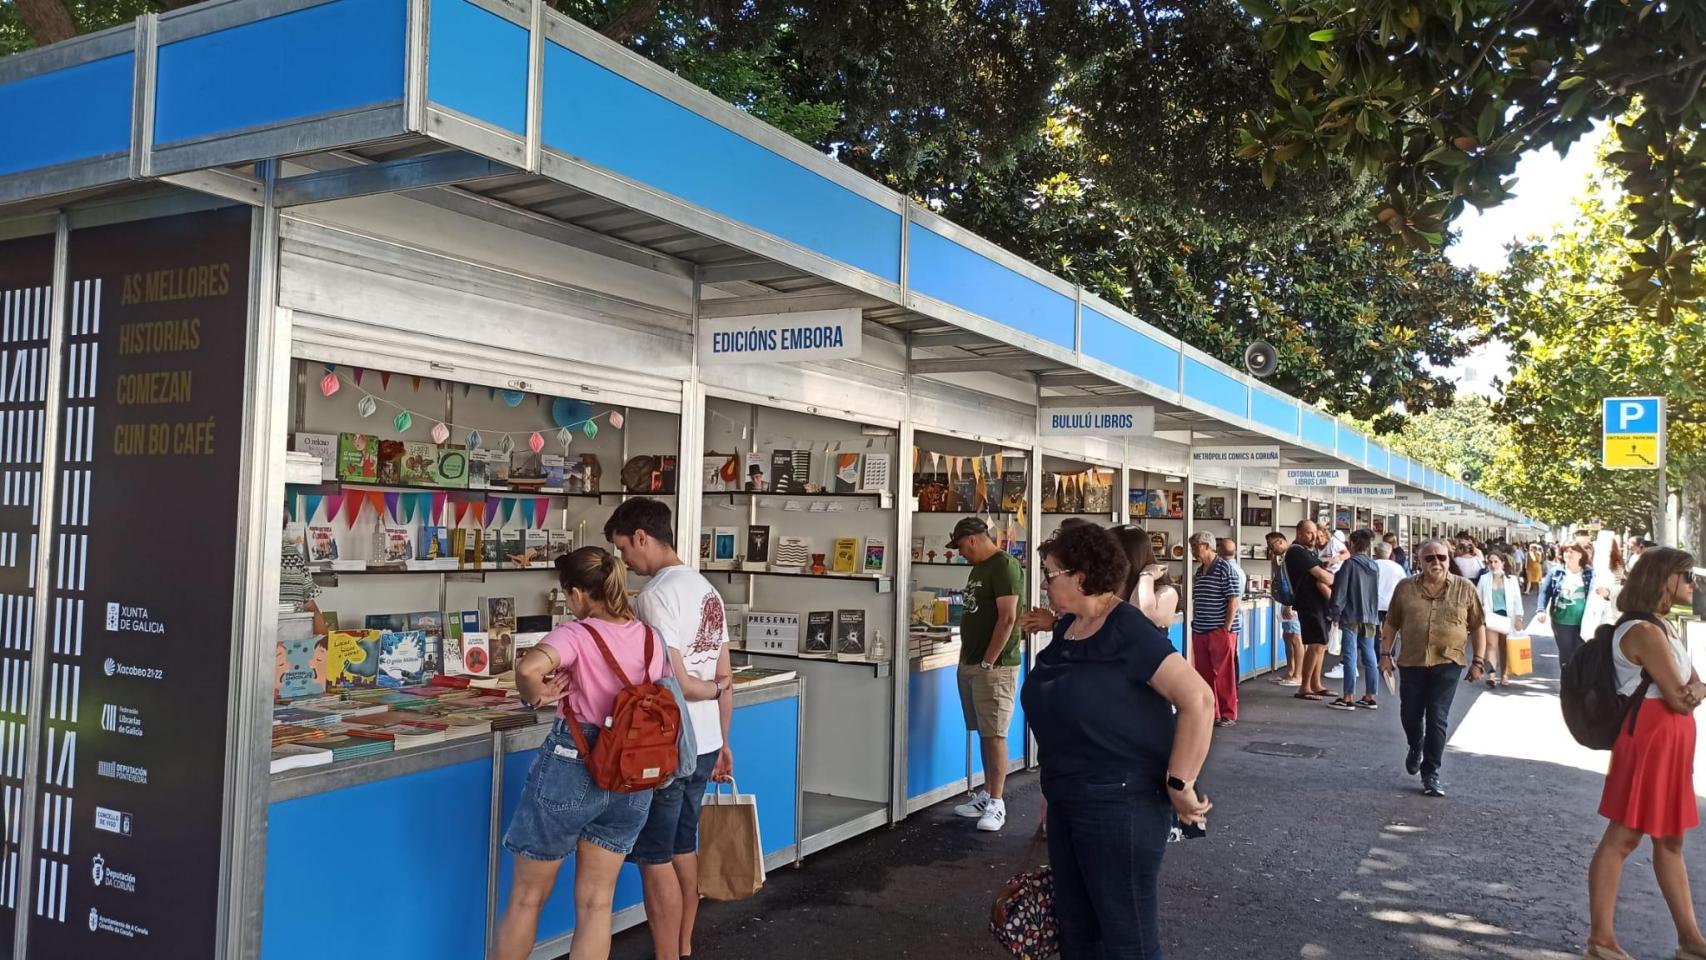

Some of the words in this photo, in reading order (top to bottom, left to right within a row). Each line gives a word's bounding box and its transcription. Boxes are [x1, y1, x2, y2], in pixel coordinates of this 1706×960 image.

[122, 274, 141, 305] AS
[146, 263, 230, 301] MELLORES
[120, 318, 200, 354] HISTORIAS
[713, 326, 777, 353] EDICIÓNS
[781, 325, 843, 350] EMBORA
[117, 371, 192, 404] COMEZAN
[1052, 411, 1092, 429] BULULÚ
[1095, 414, 1133, 428] LIBROS
[1619, 402, 1645, 430] P
[114, 424, 145, 455] CUN
[150, 423, 170, 454] BO
[173, 416, 216, 455] CAFÉ
[1228, 452, 1249, 460] COMICS
[1250, 452, 1255, 460] A
[1255, 451, 1279, 460] CORUÑA
[1288, 470, 1316, 478] EDITORIAL
[1316, 470, 1339, 478] CANELA
[1295, 478, 1314, 486] LIBROS
[1316, 478, 1327, 486] LAR
[1337, 486, 1362, 495] LIBRERÍA
[121, 606, 148, 618] XUNTA
[748, 615, 798, 624] PRESENTA
[120, 620, 130, 631] DE
[132, 621, 165, 634] GALICIA
[117, 663, 146, 677] Xacobeo
[119, 724, 125, 733] de
[125, 726, 143, 737] Galicia
[116, 763, 147, 777] DEPUTACIÓN
[116, 772, 147, 784] PONTEVEDRA
[98, 811, 119, 821] CONCELLO
[106, 820, 117, 828] VIGO
[105, 867, 136, 884] Deputación
[105, 877, 112, 886] DA
[113, 879, 135, 892] CORUÑA
